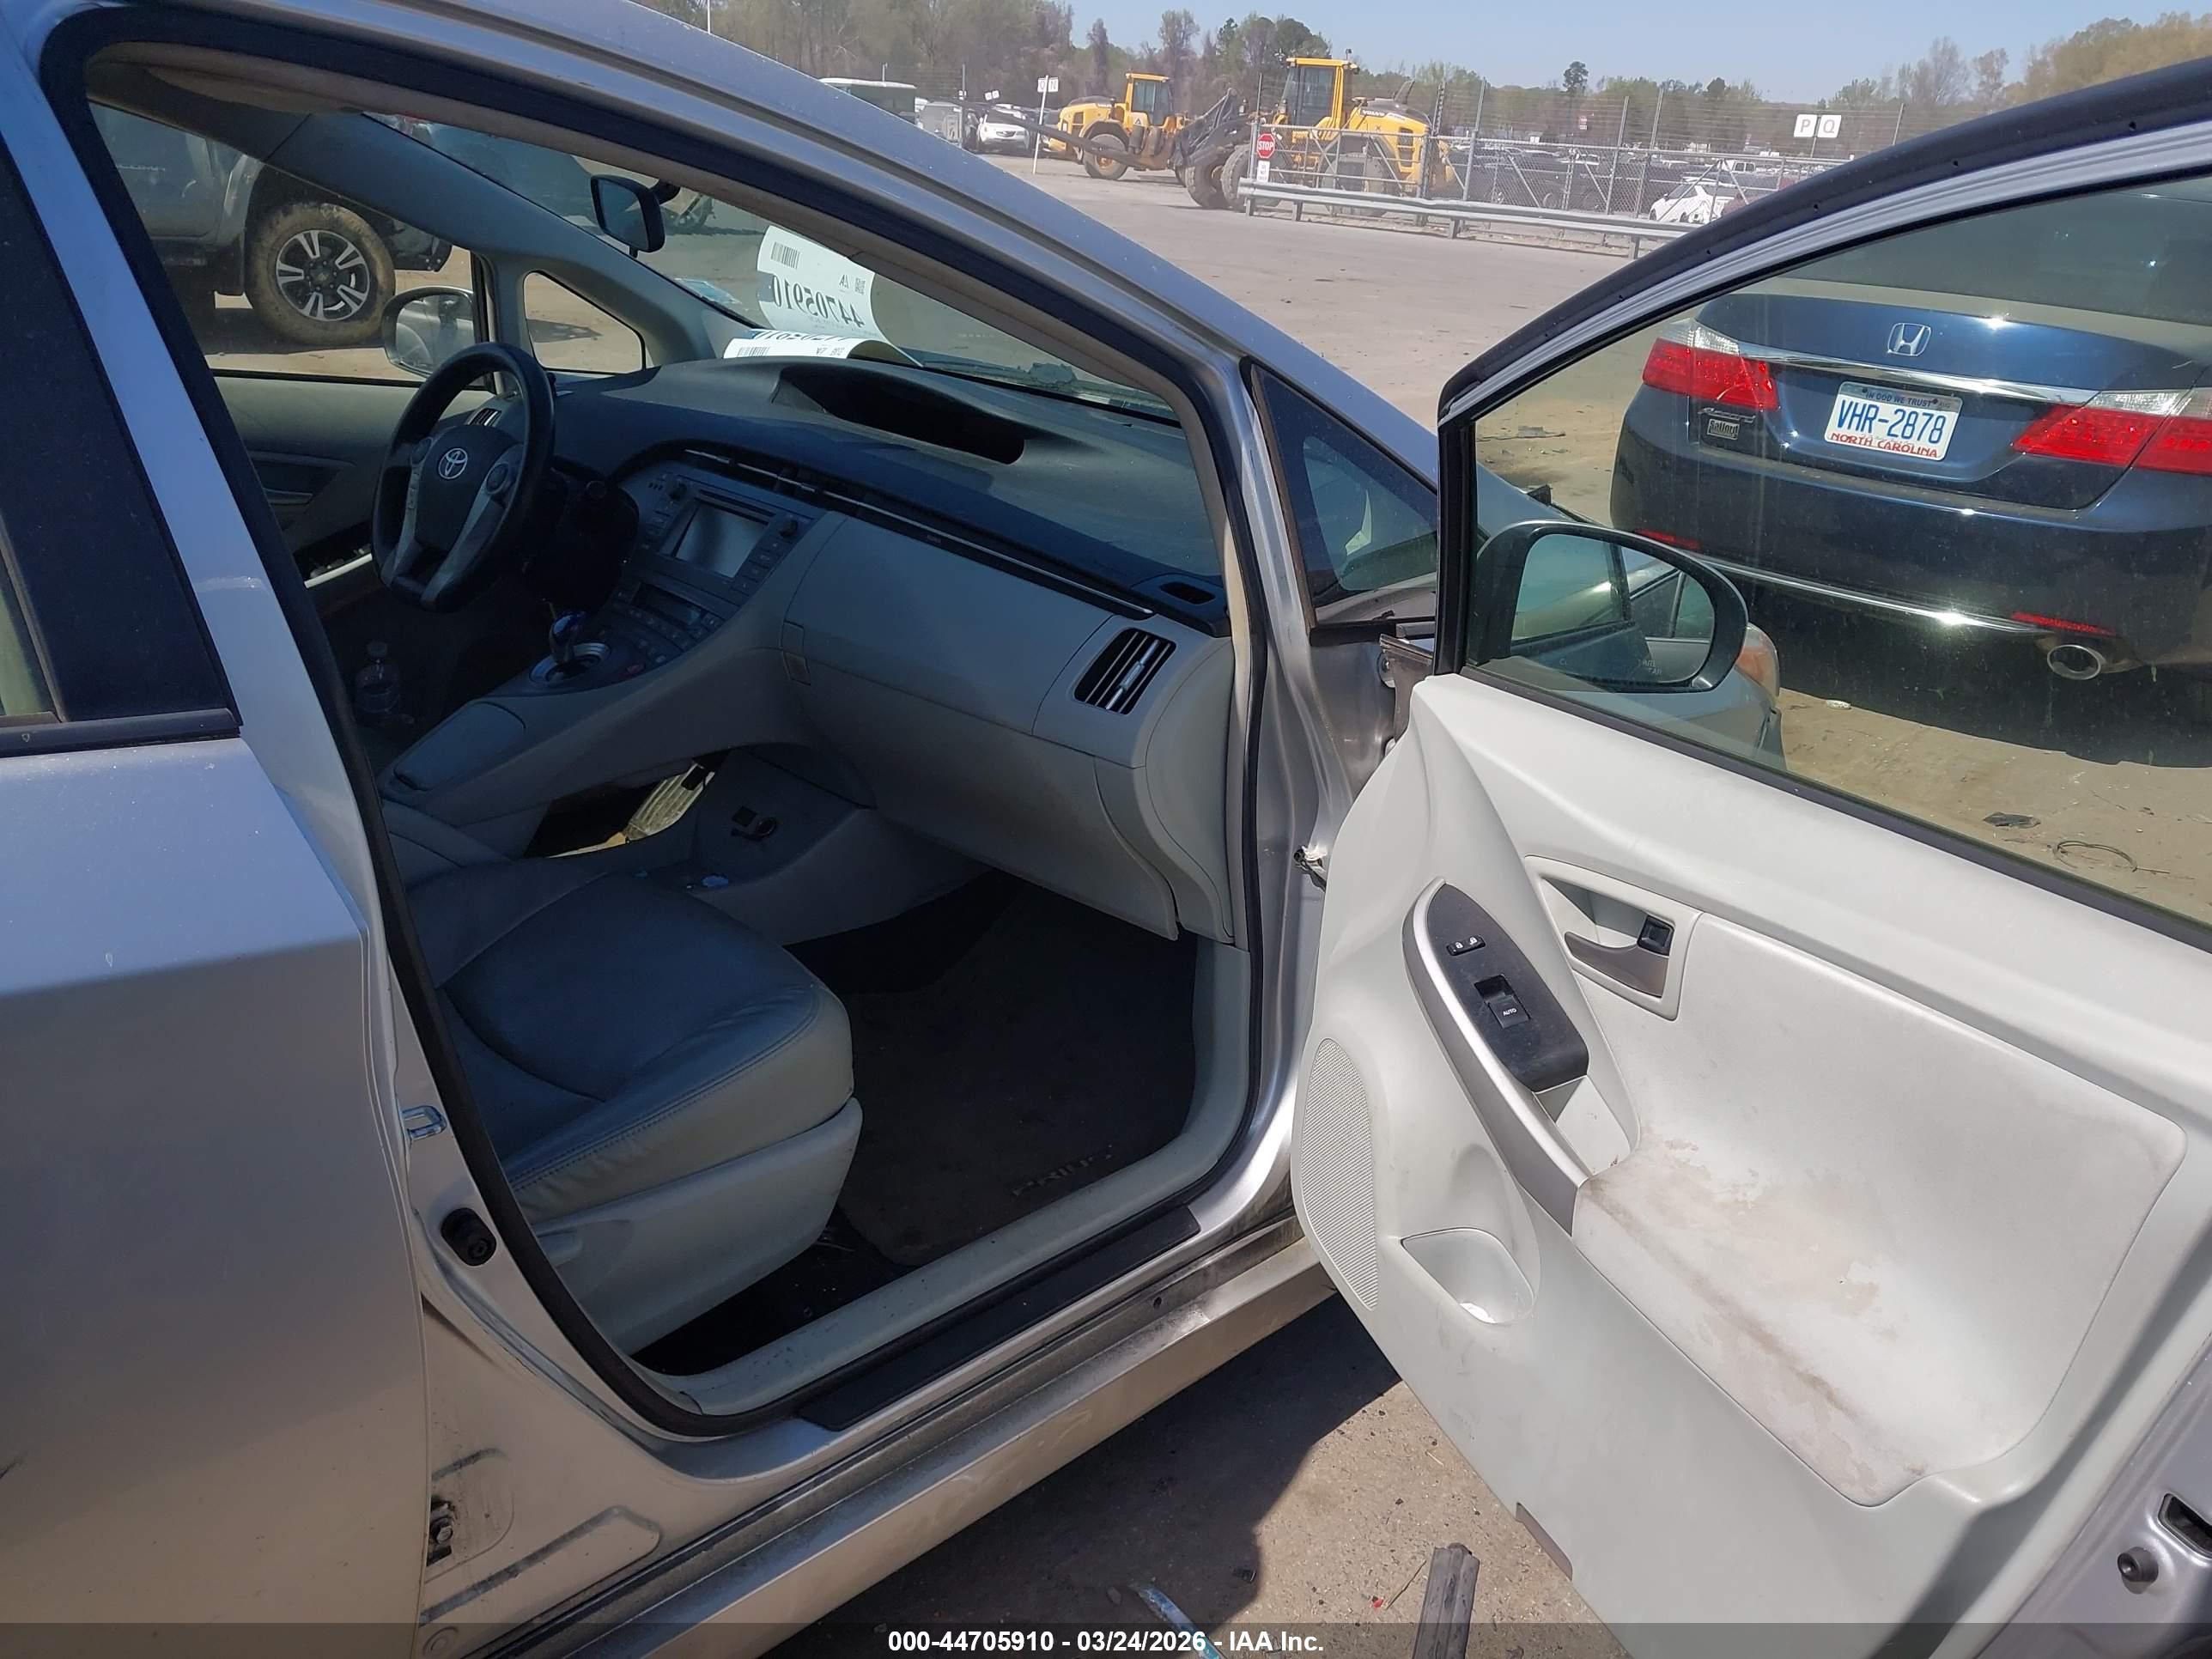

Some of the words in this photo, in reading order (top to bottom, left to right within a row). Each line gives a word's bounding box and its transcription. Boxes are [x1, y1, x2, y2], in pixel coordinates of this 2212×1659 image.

[1800, 118, 1811, 133] P
[1823, 118, 1835, 134] Q
[1258, 140, 1274, 151] STOP
[1864, 391, 1875, 399] IN
[1875, 392, 1892, 402] GOD
[1893, 395, 1905, 404] WE
[1907, 397, 1933, 408] TRUST
[1837, 398, 1947, 445] VHR-2878
[1830, 432, 1873, 447] NORTH
[1877, 440, 1938, 459] CAROLINA
[1503, 1008, 1516, 1017] AUTO
